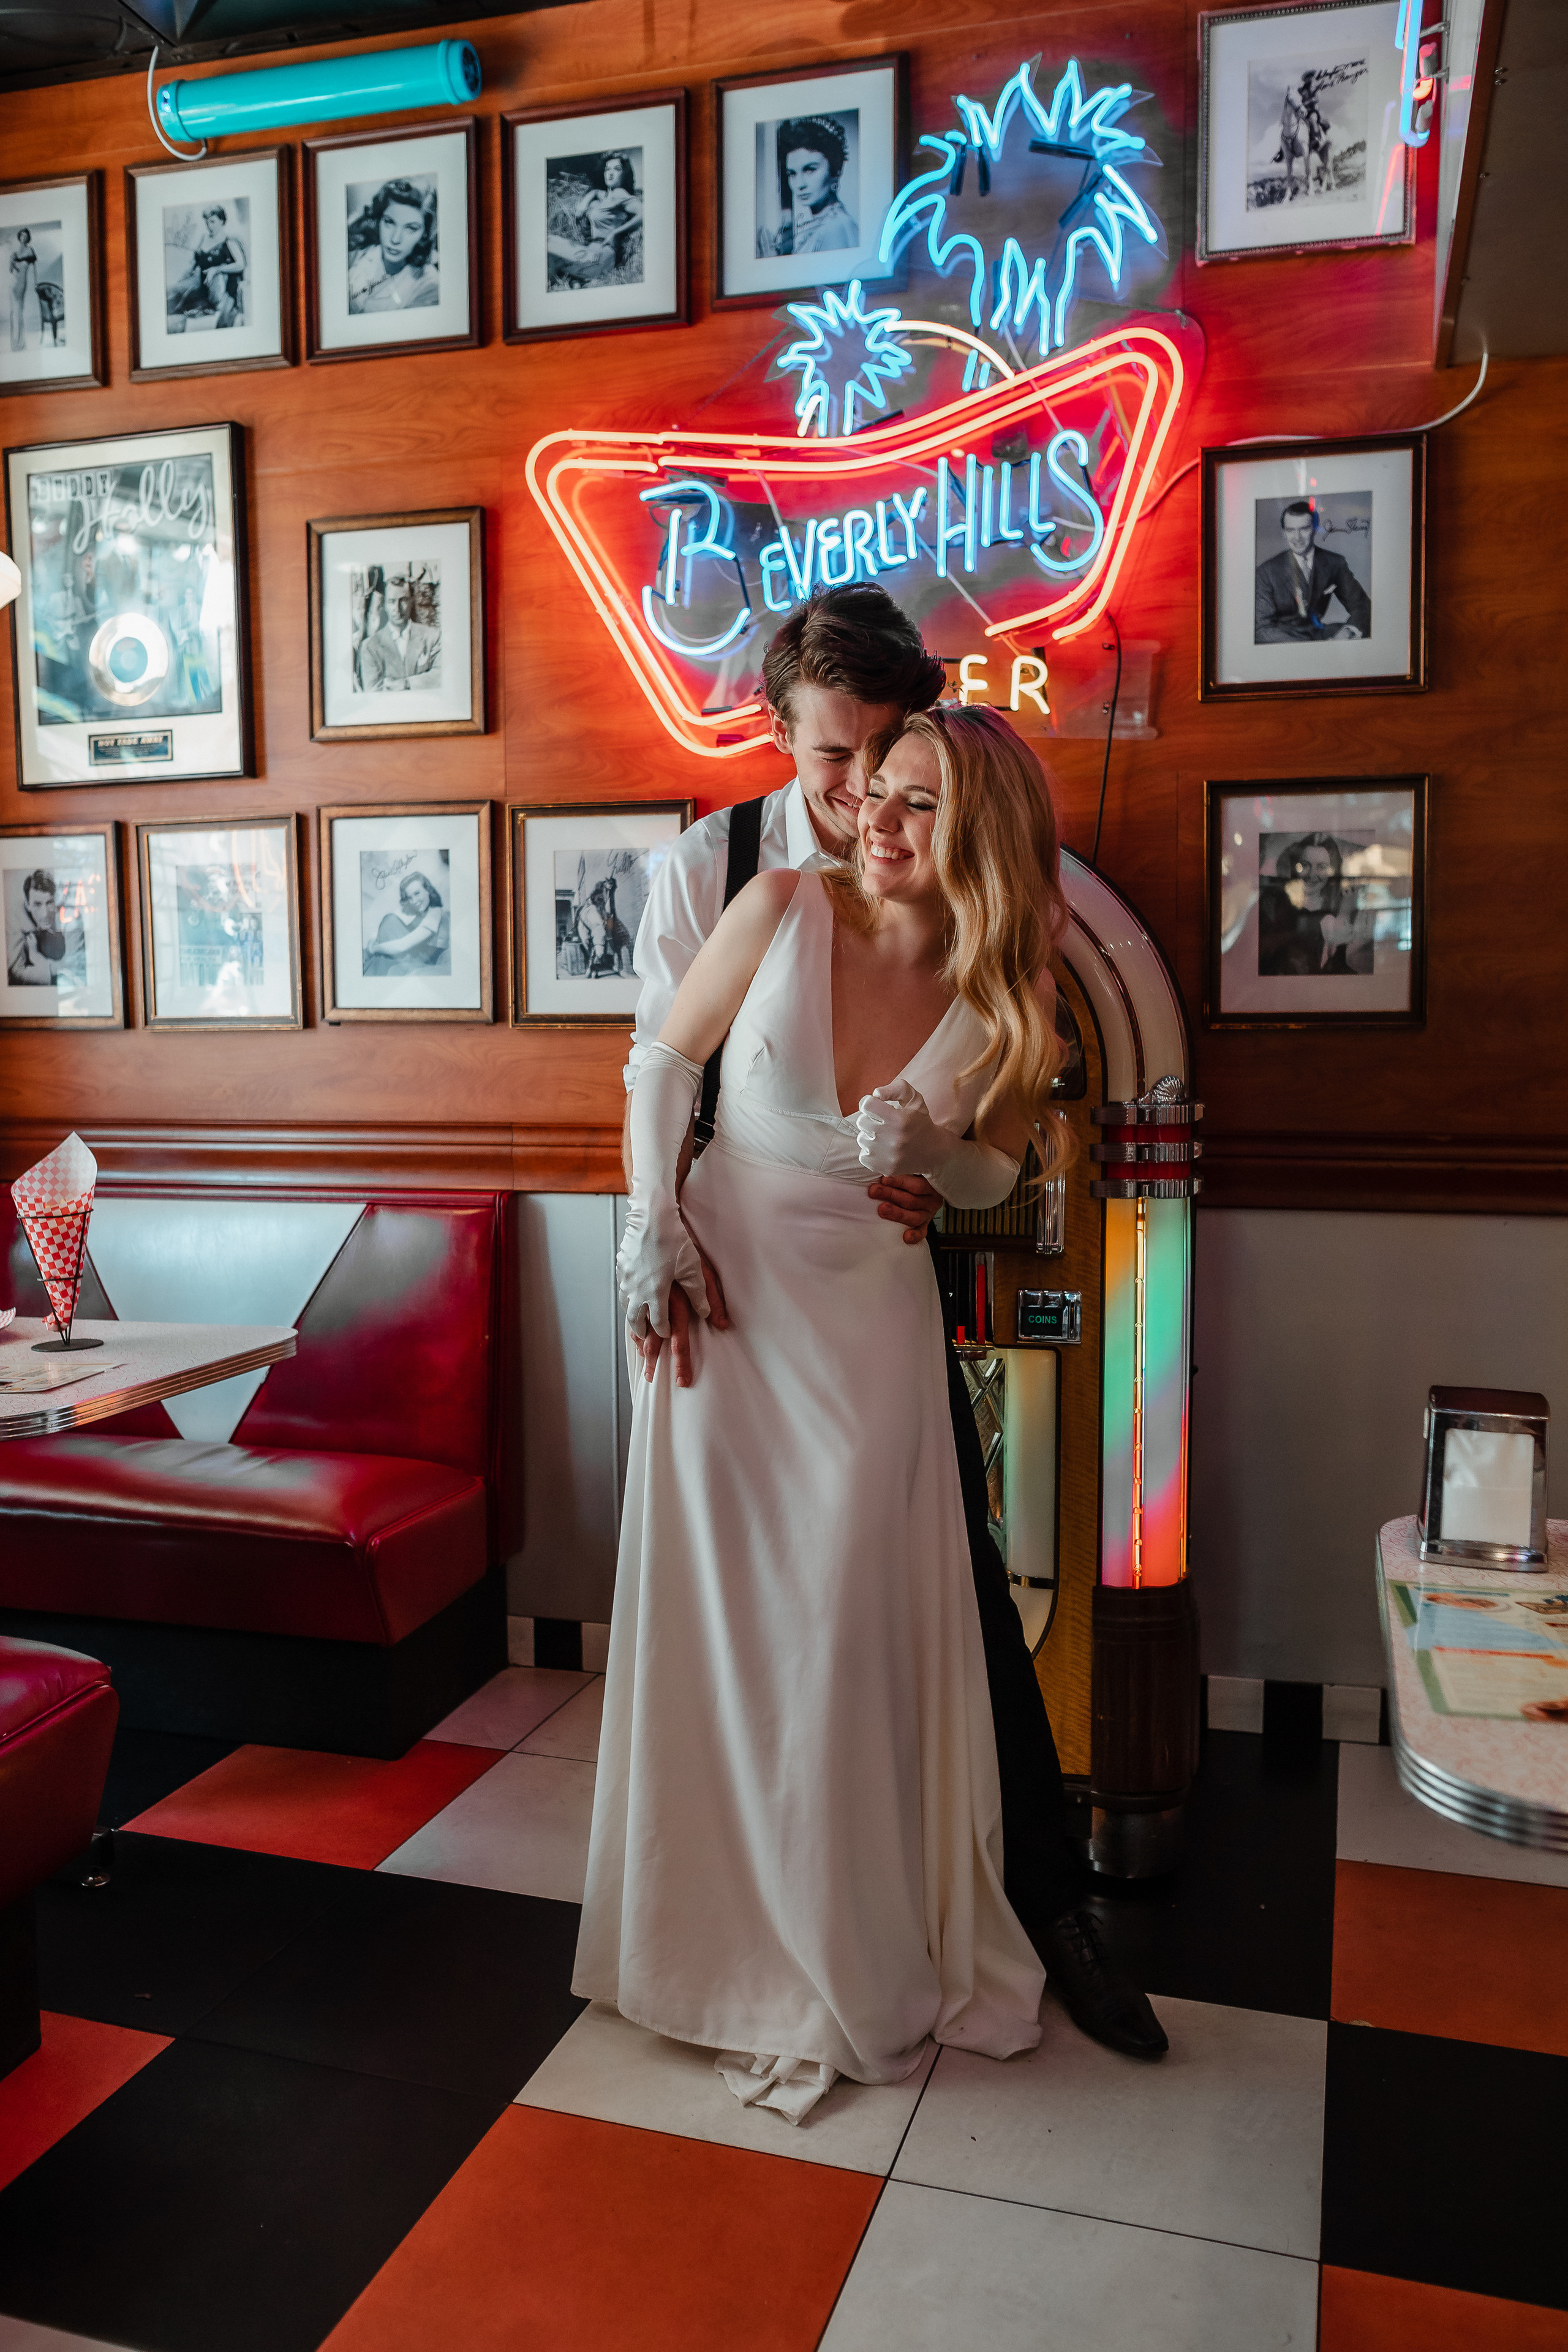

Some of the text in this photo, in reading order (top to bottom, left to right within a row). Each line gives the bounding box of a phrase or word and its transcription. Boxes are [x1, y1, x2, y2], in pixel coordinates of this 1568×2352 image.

[72, 459, 208, 555] Holly
[937, 430, 1103, 578] HILLS
[1028, 1315, 1057, 1324] COINS
